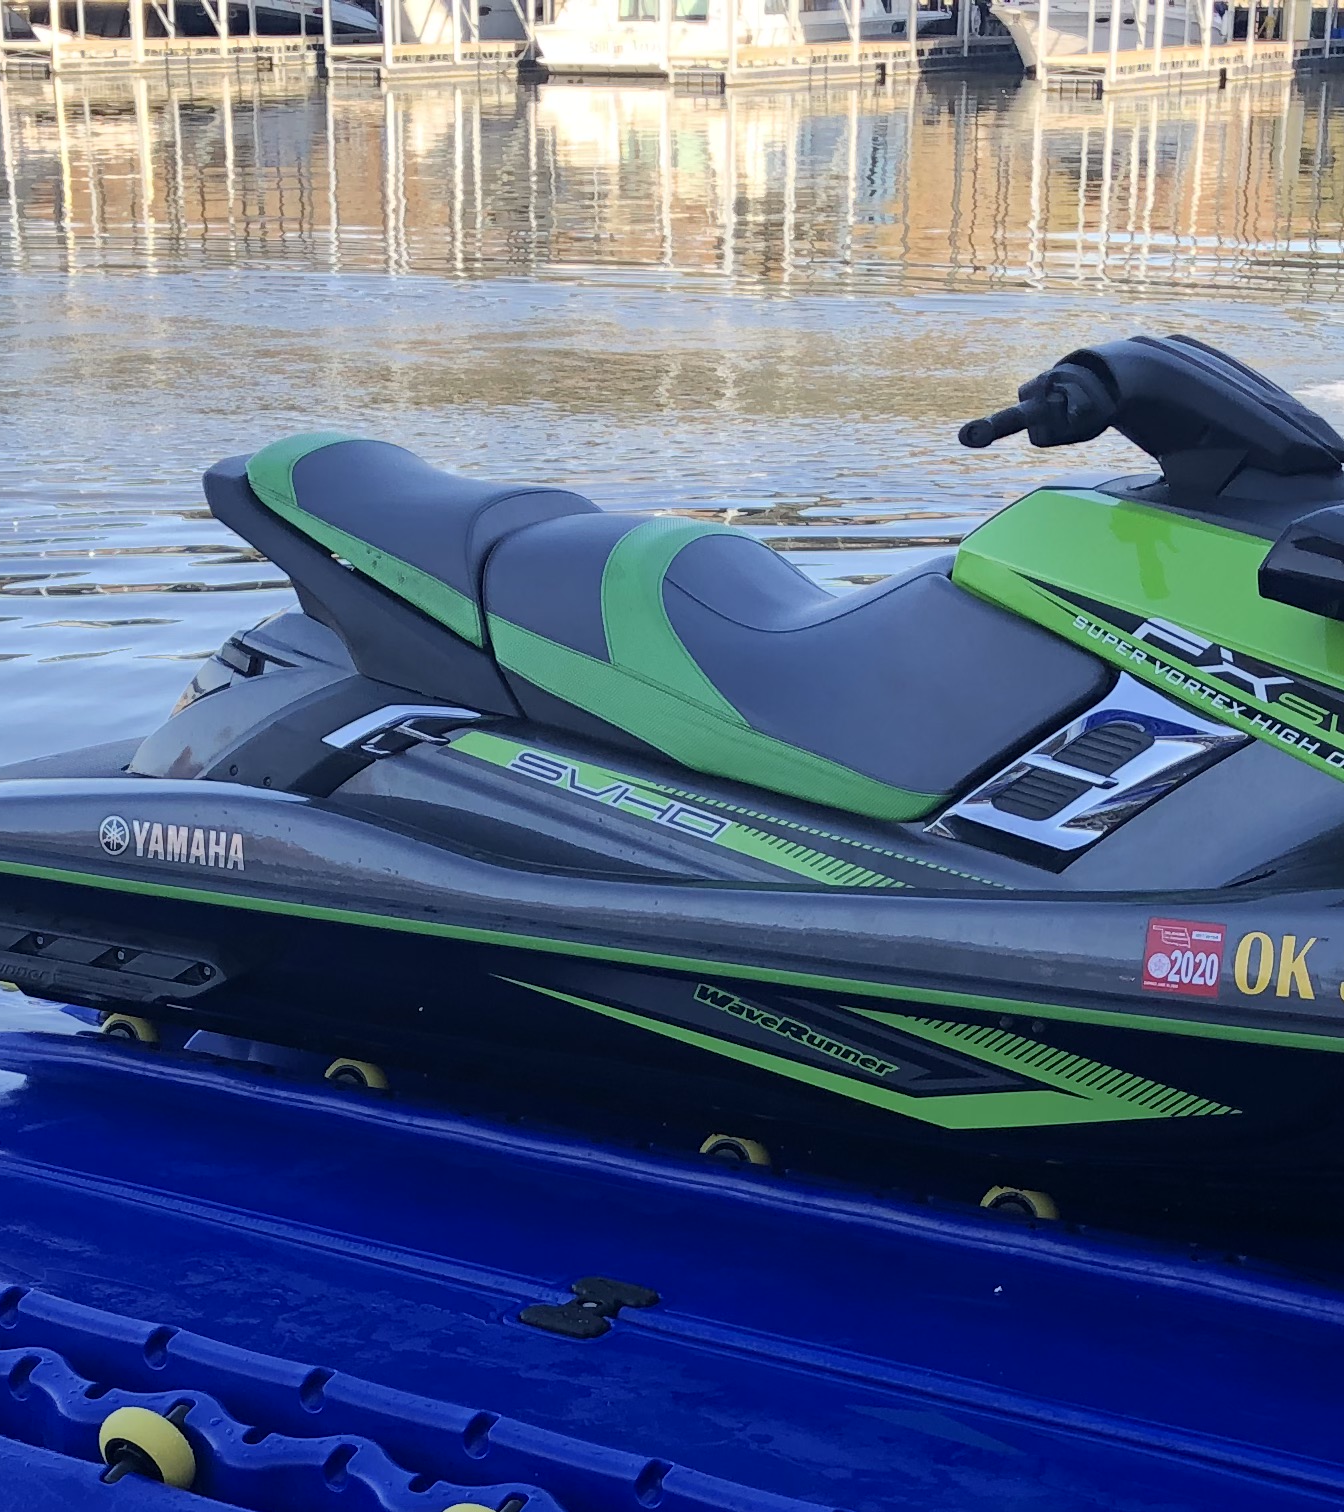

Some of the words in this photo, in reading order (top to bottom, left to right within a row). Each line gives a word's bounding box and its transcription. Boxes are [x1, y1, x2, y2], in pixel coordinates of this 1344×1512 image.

[1071, 614, 1148, 666] SUPER
[1153, 659, 1249, 719] VORTEX
[1249, 713, 1322, 756] HIGH
[1131, 617, 1295, 703] FX
[507, 750, 733, 843] SVHO
[131, 818, 246, 872] YAMAHA
[1167, 949, 1219, 987] 2020
[1233, 931, 1317, 1000] OK
[693, 983, 901, 1077] WaveRunner
